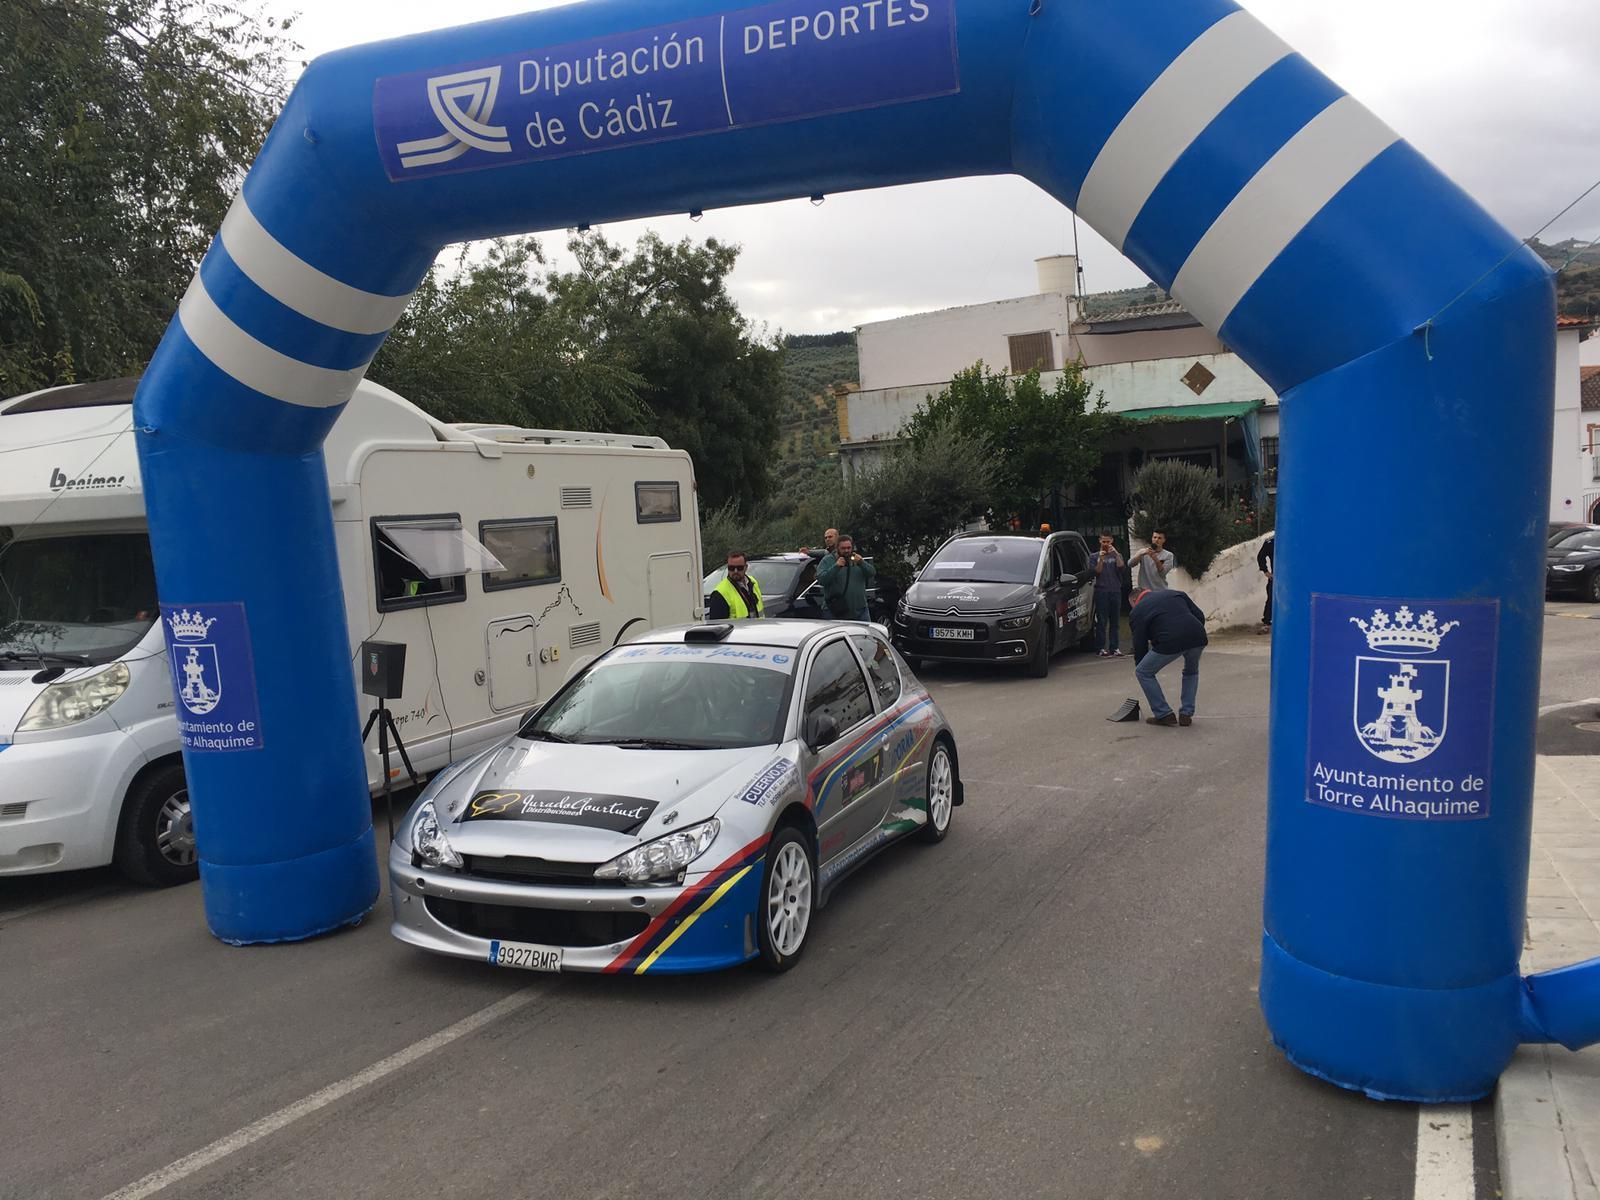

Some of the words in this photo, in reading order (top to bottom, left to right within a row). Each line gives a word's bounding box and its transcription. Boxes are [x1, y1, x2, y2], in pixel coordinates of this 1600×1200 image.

[743, 0, 930, 54] DEPORTES
[519, 32, 704, 96] Diputación
[525, 111, 567, 149] de
[578, 92, 677, 140] Cádiz
[49, 467, 125, 492] benimar
[935, 628, 954, 638] 9575
[957, 629, 973, 638] KMH
[237, 719, 255, 732] de
[391, 714, 409, 729] rope
[411, 707, 425, 720] 740
[193, 735, 255, 751] Alhaquime
[1313, 761, 1454, 793] Ayuntamiento
[1461, 774, 1484, 792] de
[1315, 783, 1365, 808] Torre
[1369, 793, 1480, 818] Alhaquime
[497, 946, 559, 970] 9927BMR
